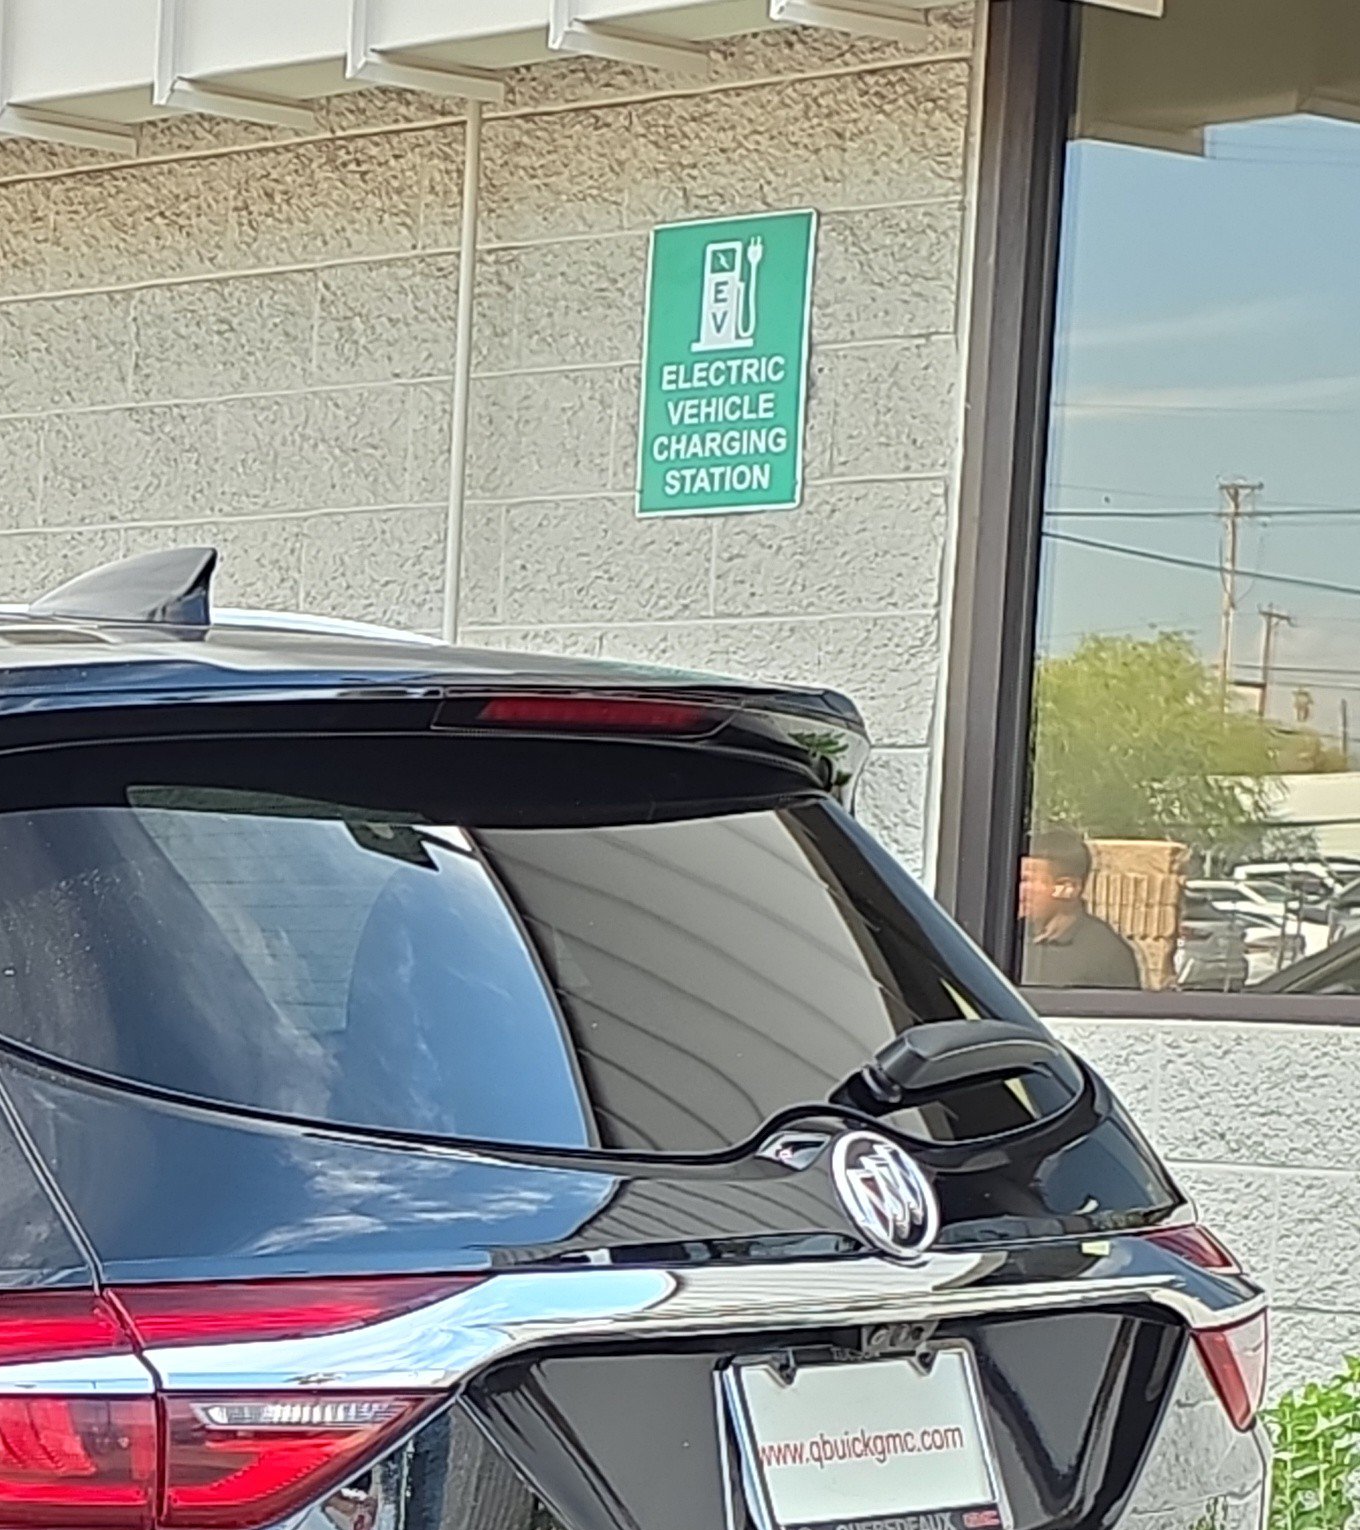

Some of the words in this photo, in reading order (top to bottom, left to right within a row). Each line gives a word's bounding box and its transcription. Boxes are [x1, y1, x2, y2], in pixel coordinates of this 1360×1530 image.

[661, 356, 785, 391] ELECTRIC
[667, 393, 775, 425] VEHICLE
[653, 427, 787, 461] CHARGING
[665, 464, 770, 495] STATION
[760, 1427, 964, 1468] www.qbuickgmc.com
